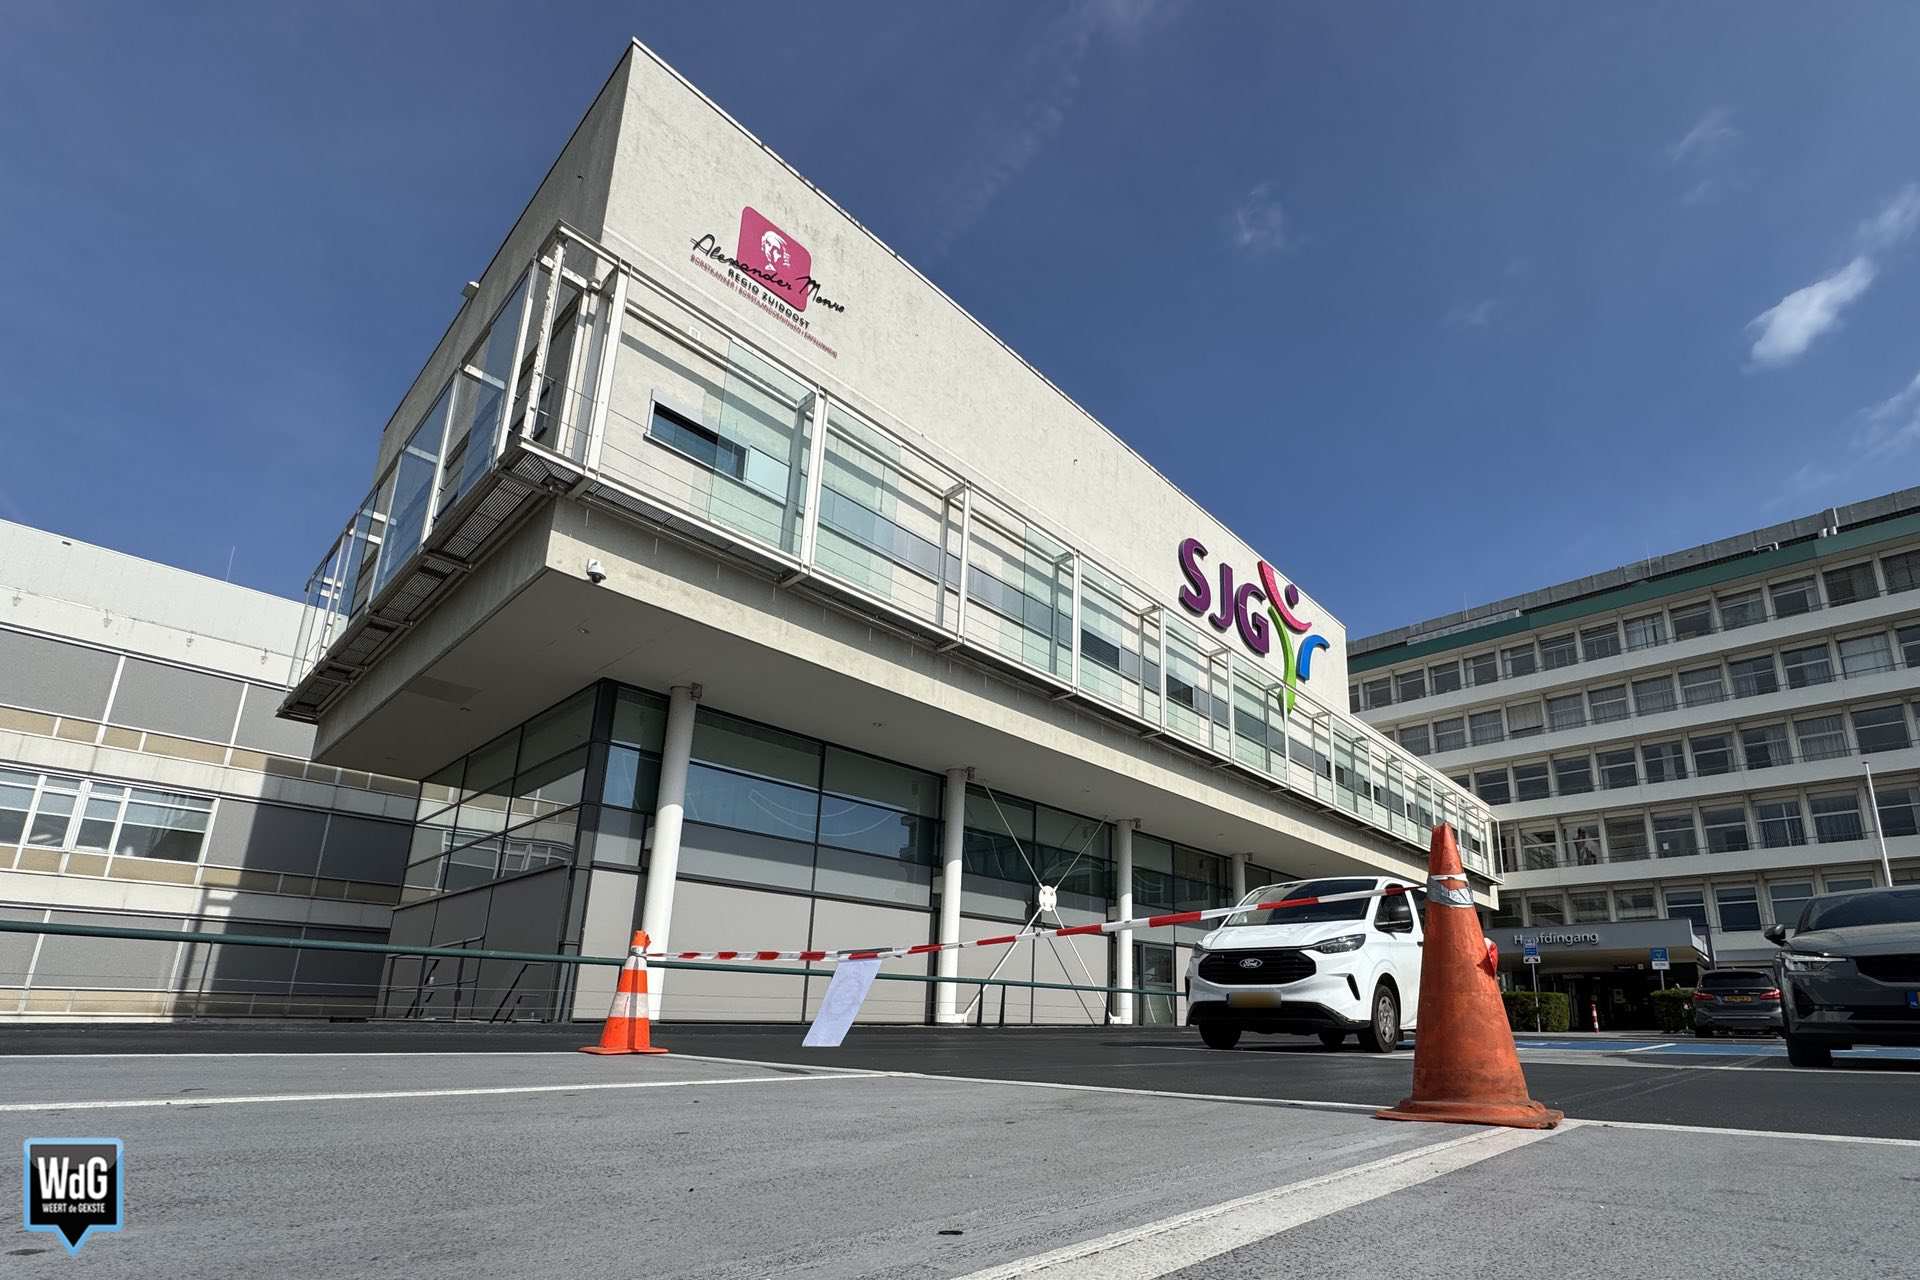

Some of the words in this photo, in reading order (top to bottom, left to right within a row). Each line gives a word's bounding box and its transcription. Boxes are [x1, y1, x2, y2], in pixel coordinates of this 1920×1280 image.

[690, 233, 792, 291] Alexander
[728, 268, 760, 295] REGIO
[761, 294, 810, 329] ZUIDOOST
[1178, 538, 1270, 657] SJG
[1513, 931, 1600, 946] Hfdingang
